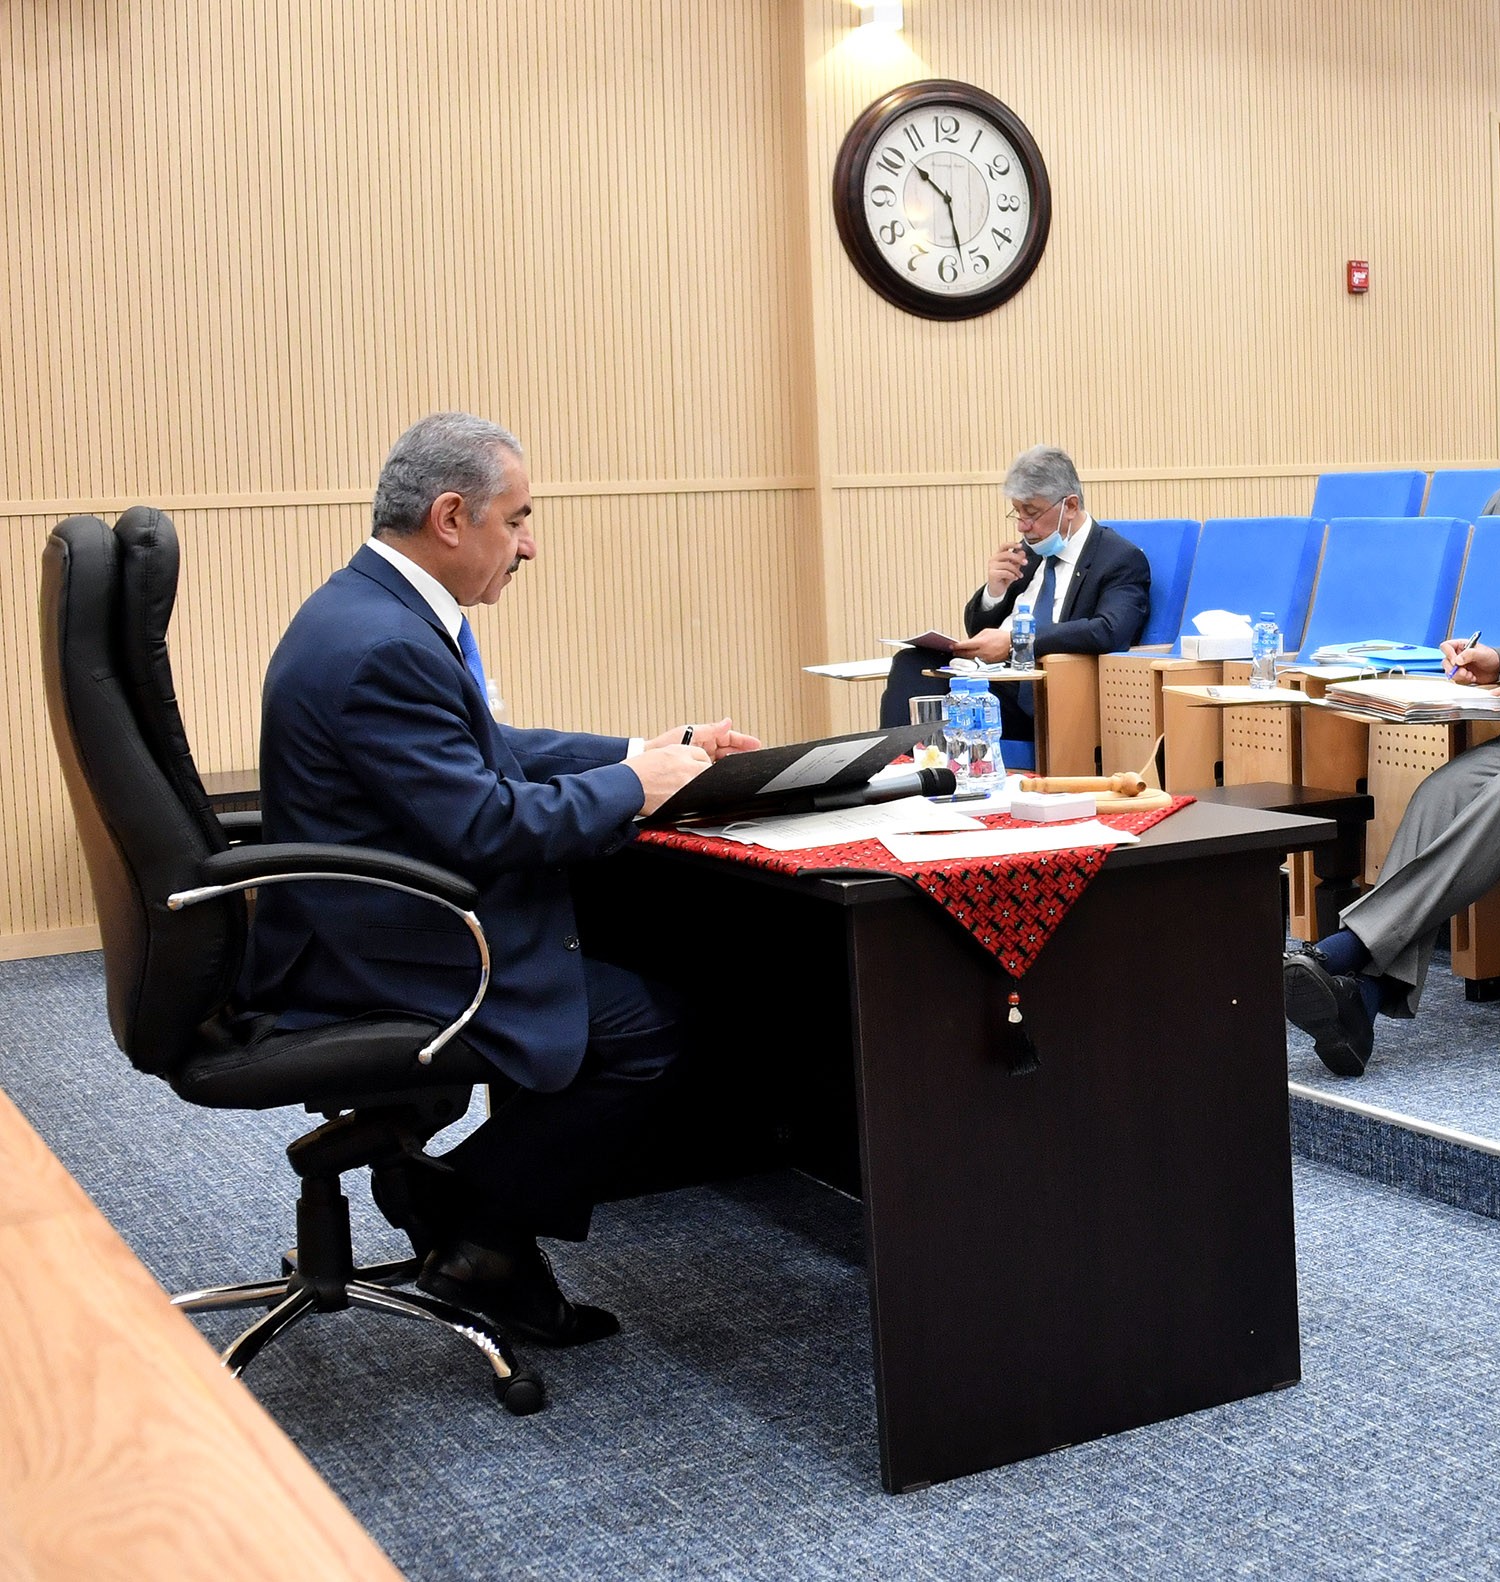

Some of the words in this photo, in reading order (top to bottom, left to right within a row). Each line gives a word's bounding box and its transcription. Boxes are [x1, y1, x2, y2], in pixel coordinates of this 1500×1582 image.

[902, 123, 926, 152] 11
[933, 115, 961, 143] 12
[969, 129, 983, 153] 1
[875, 146, 906, 177] 10
[984, 154, 1011, 181] 2
[870, 184, 898, 207] 9
[996, 193, 1021, 213] 3
[878, 219, 906, 246] 8
[990, 226, 1013, 252] 4
[907, 244, 930, 273] 7
[937, 255, 958, 284] 6
[968, 246, 990, 275] 5
